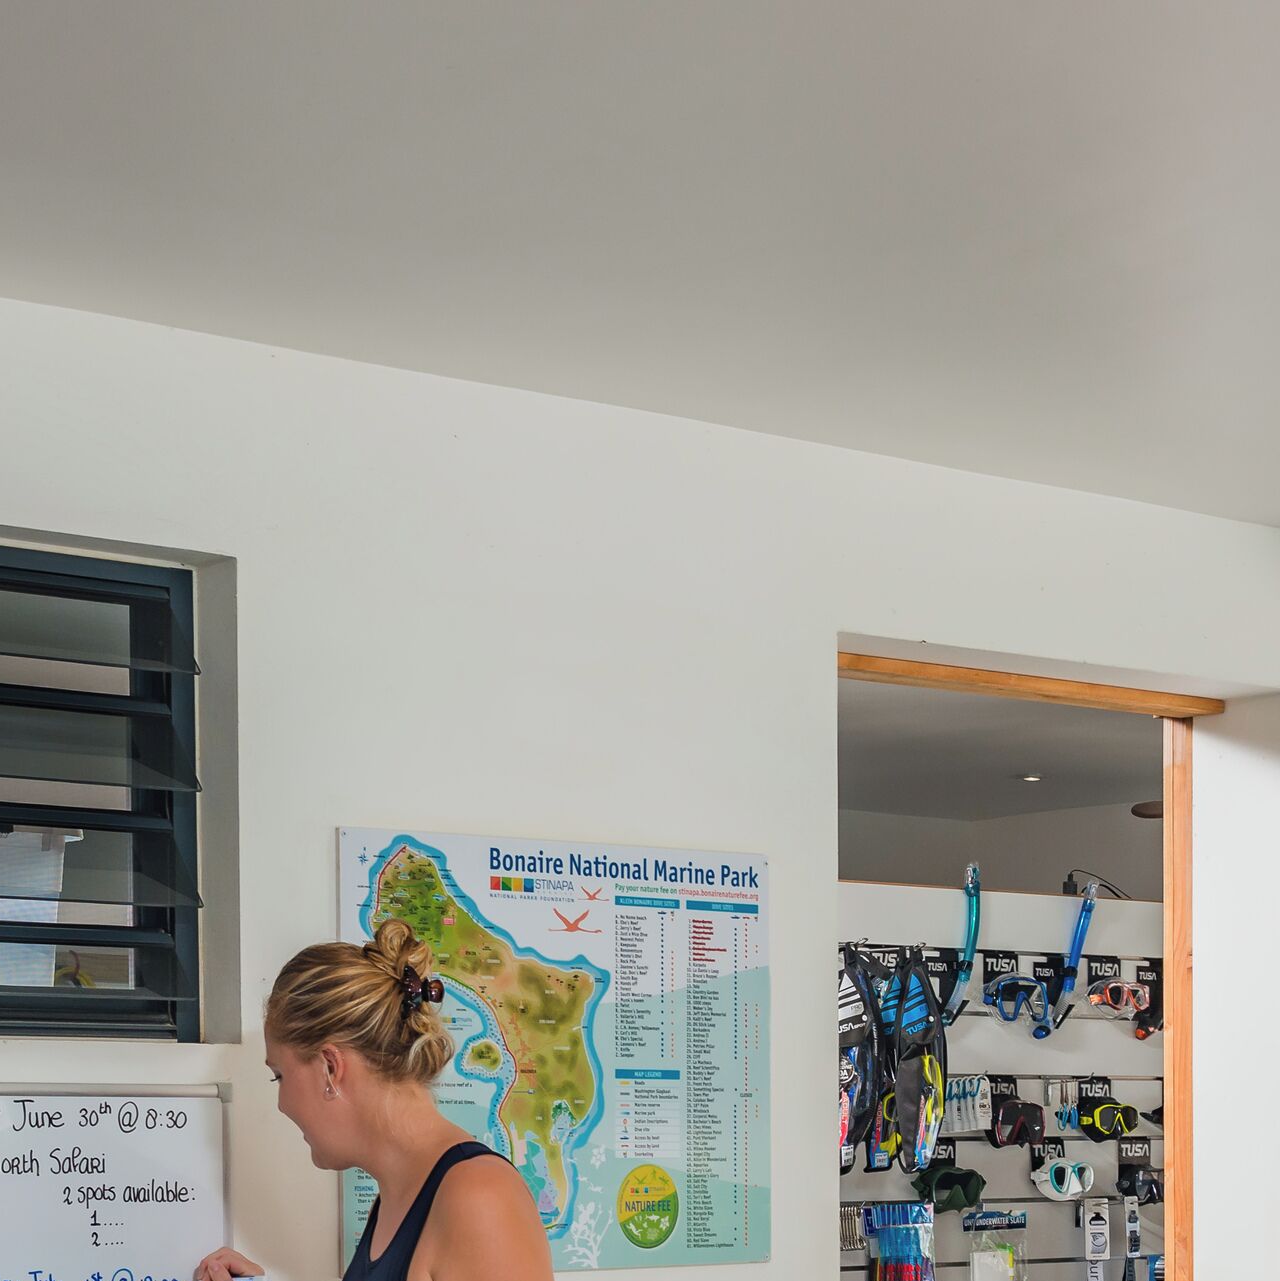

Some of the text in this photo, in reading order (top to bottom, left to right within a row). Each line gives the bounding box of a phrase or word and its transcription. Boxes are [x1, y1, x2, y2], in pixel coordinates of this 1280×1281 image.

[490, 848, 758, 888] Bonaire National Marine Park
[535, 878, 574, 891] STINAPA
[615, 883, 625, 892] Pay
[626, 885, 639, 893] your
[678, 888, 758, 901] stinapa.bonairenaturefee.org
[927, 961, 948, 972] TUSA
[986, 958, 1017, 973] TUSA
[1035, 966, 1054, 978] TUSA
[1090, 961, 1119, 977] TUSA
[1139, 971, 1157, 981] TUSA
[906, 1021, 928, 1036] TUSA
[1080, 1082, 1110, 1098] TUSA
[12, 1099, 65, 1132] June
[78, 1102, 112, 1128] 30th
[118, 1101, 139, 1133] @
[145, 1108, 187, 1130] 8:30
[1032, 1143, 1063, 1158] TUSA
[1121, 1143, 1150, 1158] TUSA
[50, 1146, 105, 1175] Safari
[63, 1179, 196, 1209] 2 spots available:
[625, 1200, 671, 1212] NATURE FEE
[976, 1215, 1025, 1226] UNDERWATER SLATE
